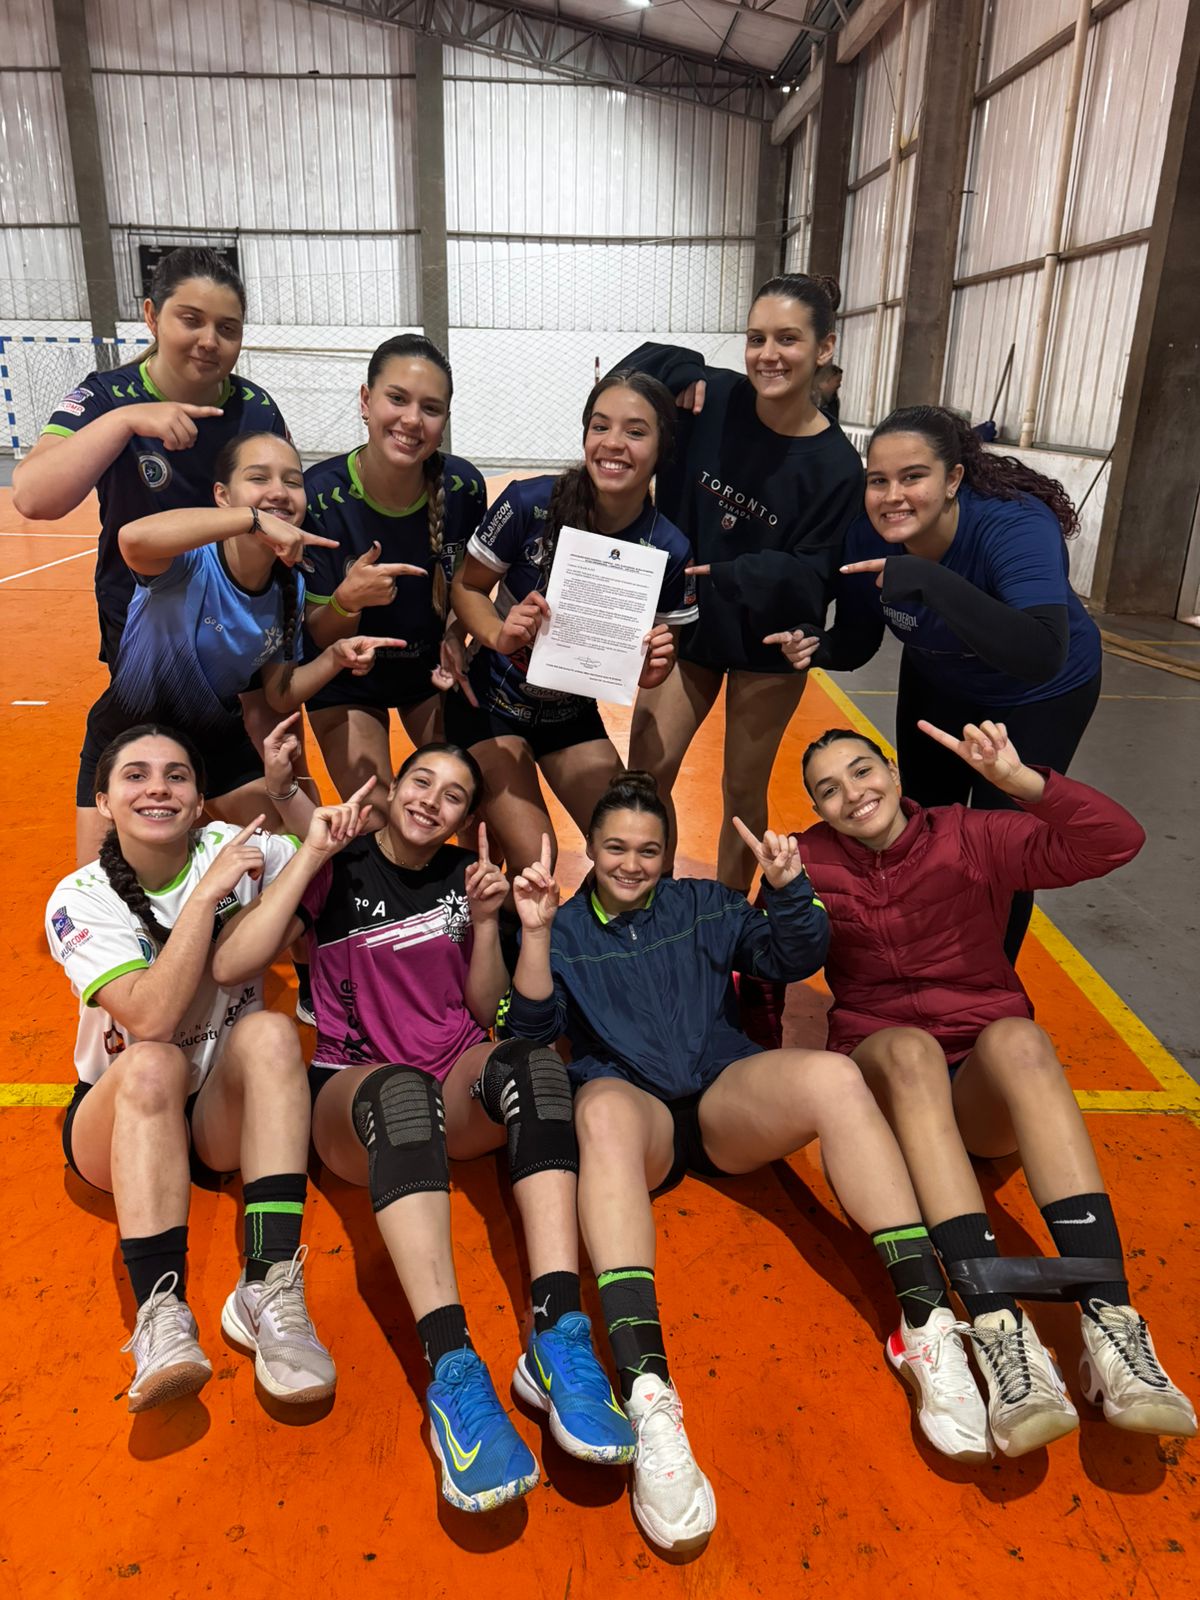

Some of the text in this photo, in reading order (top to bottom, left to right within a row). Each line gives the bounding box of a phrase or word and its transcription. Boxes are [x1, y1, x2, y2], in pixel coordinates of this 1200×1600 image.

[701, 471, 778, 525] TORONTO
[718, 500, 750, 520] CANADA
[480, 500, 511, 543] PLANECON
[215, 623, 223, 632] B
[371, 900, 386, 917] A
